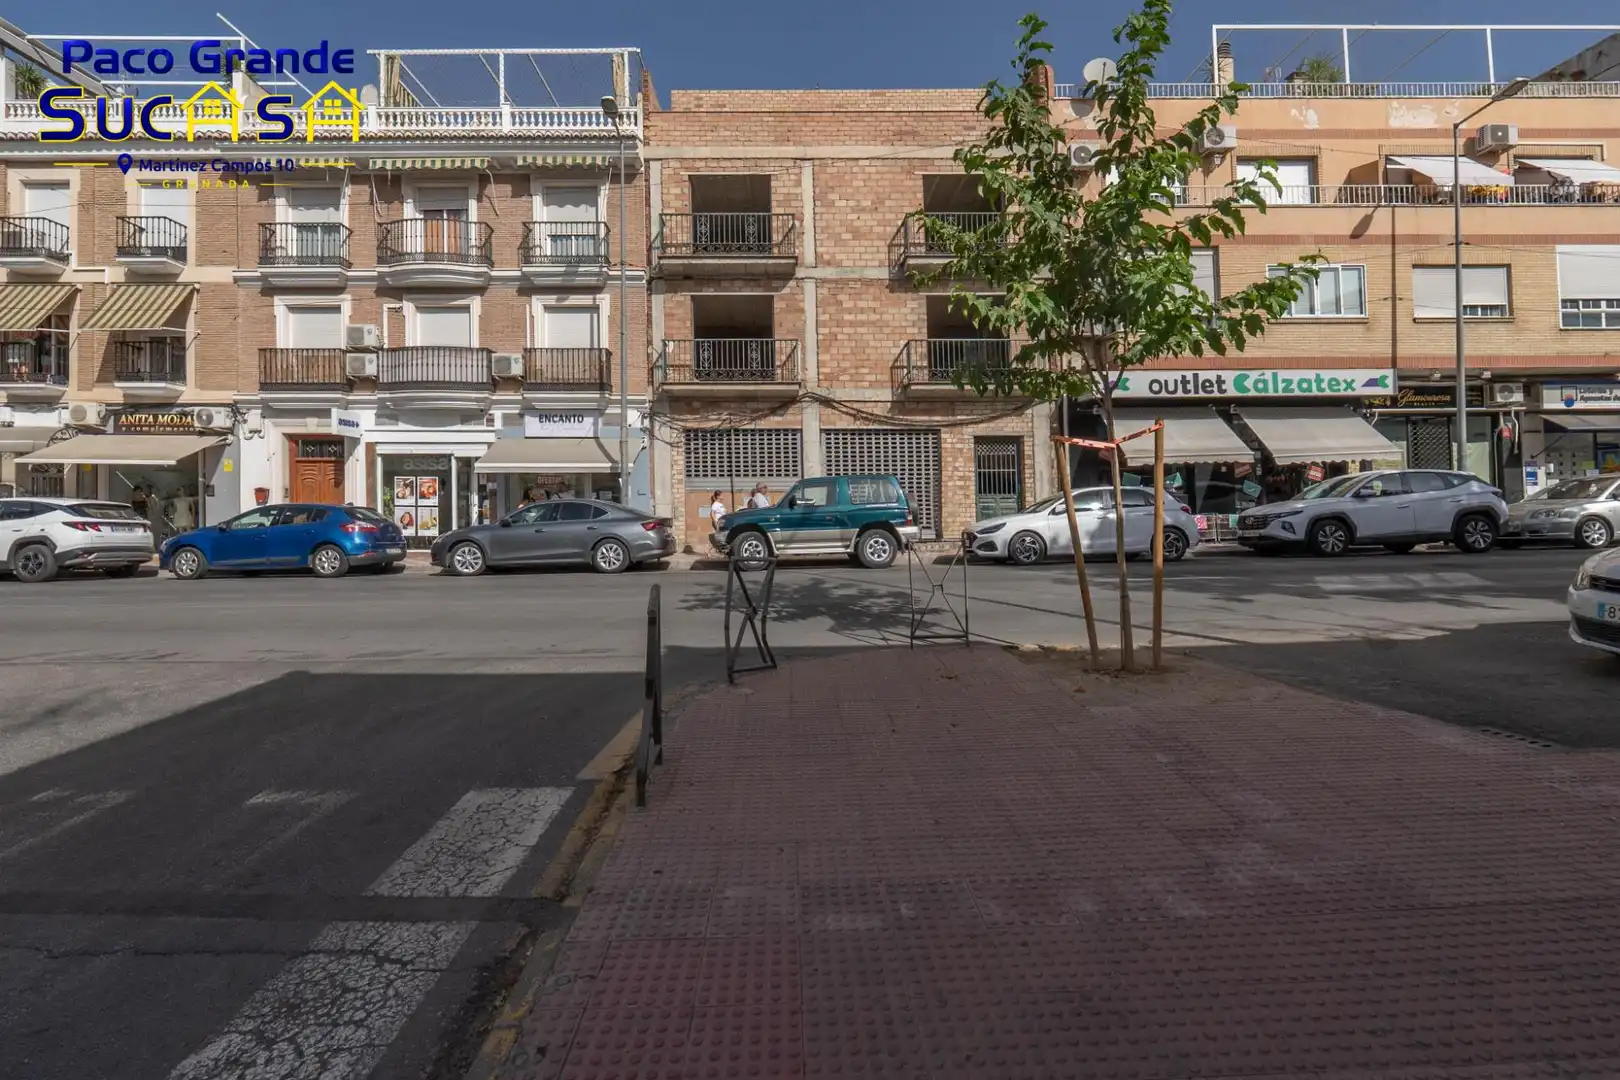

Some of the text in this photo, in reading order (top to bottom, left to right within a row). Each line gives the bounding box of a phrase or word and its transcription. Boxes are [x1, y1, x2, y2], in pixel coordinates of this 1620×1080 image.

[1148, 371, 1356, 395] outlet Cálzatex
[119, 414, 155, 425] ANITA
[538, 414, 585, 424] ENCANTO
[403, 456, 449, 470] asisa
[1608, 606, 1620, 619] 8
